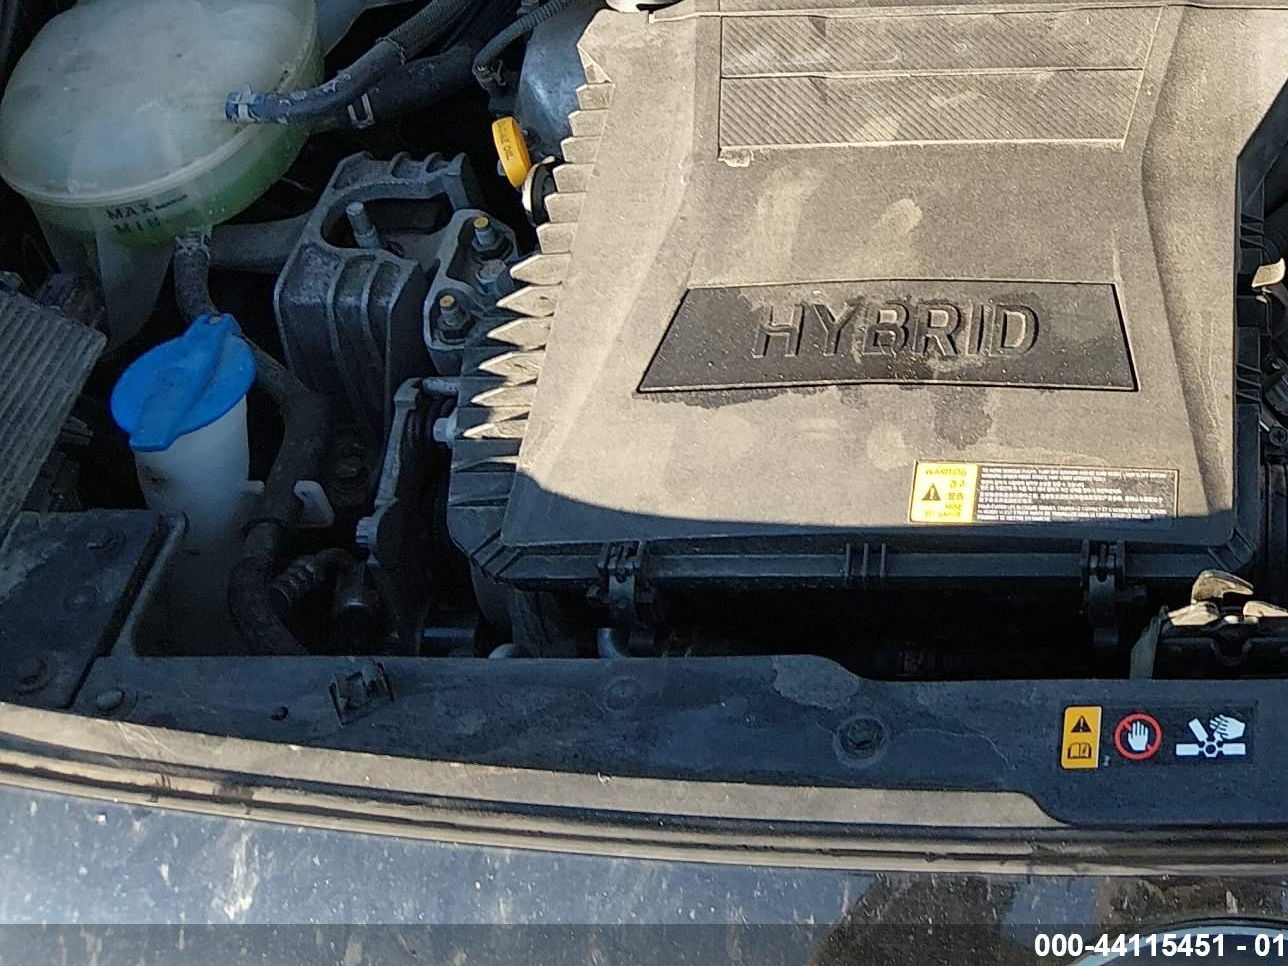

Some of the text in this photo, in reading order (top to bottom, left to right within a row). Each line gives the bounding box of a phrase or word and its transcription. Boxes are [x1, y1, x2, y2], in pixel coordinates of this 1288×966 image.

[105, 201, 154, 220] MAX
[112, 216, 161, 232] MIN
[752, 298, 1041, 361] HYBRID
